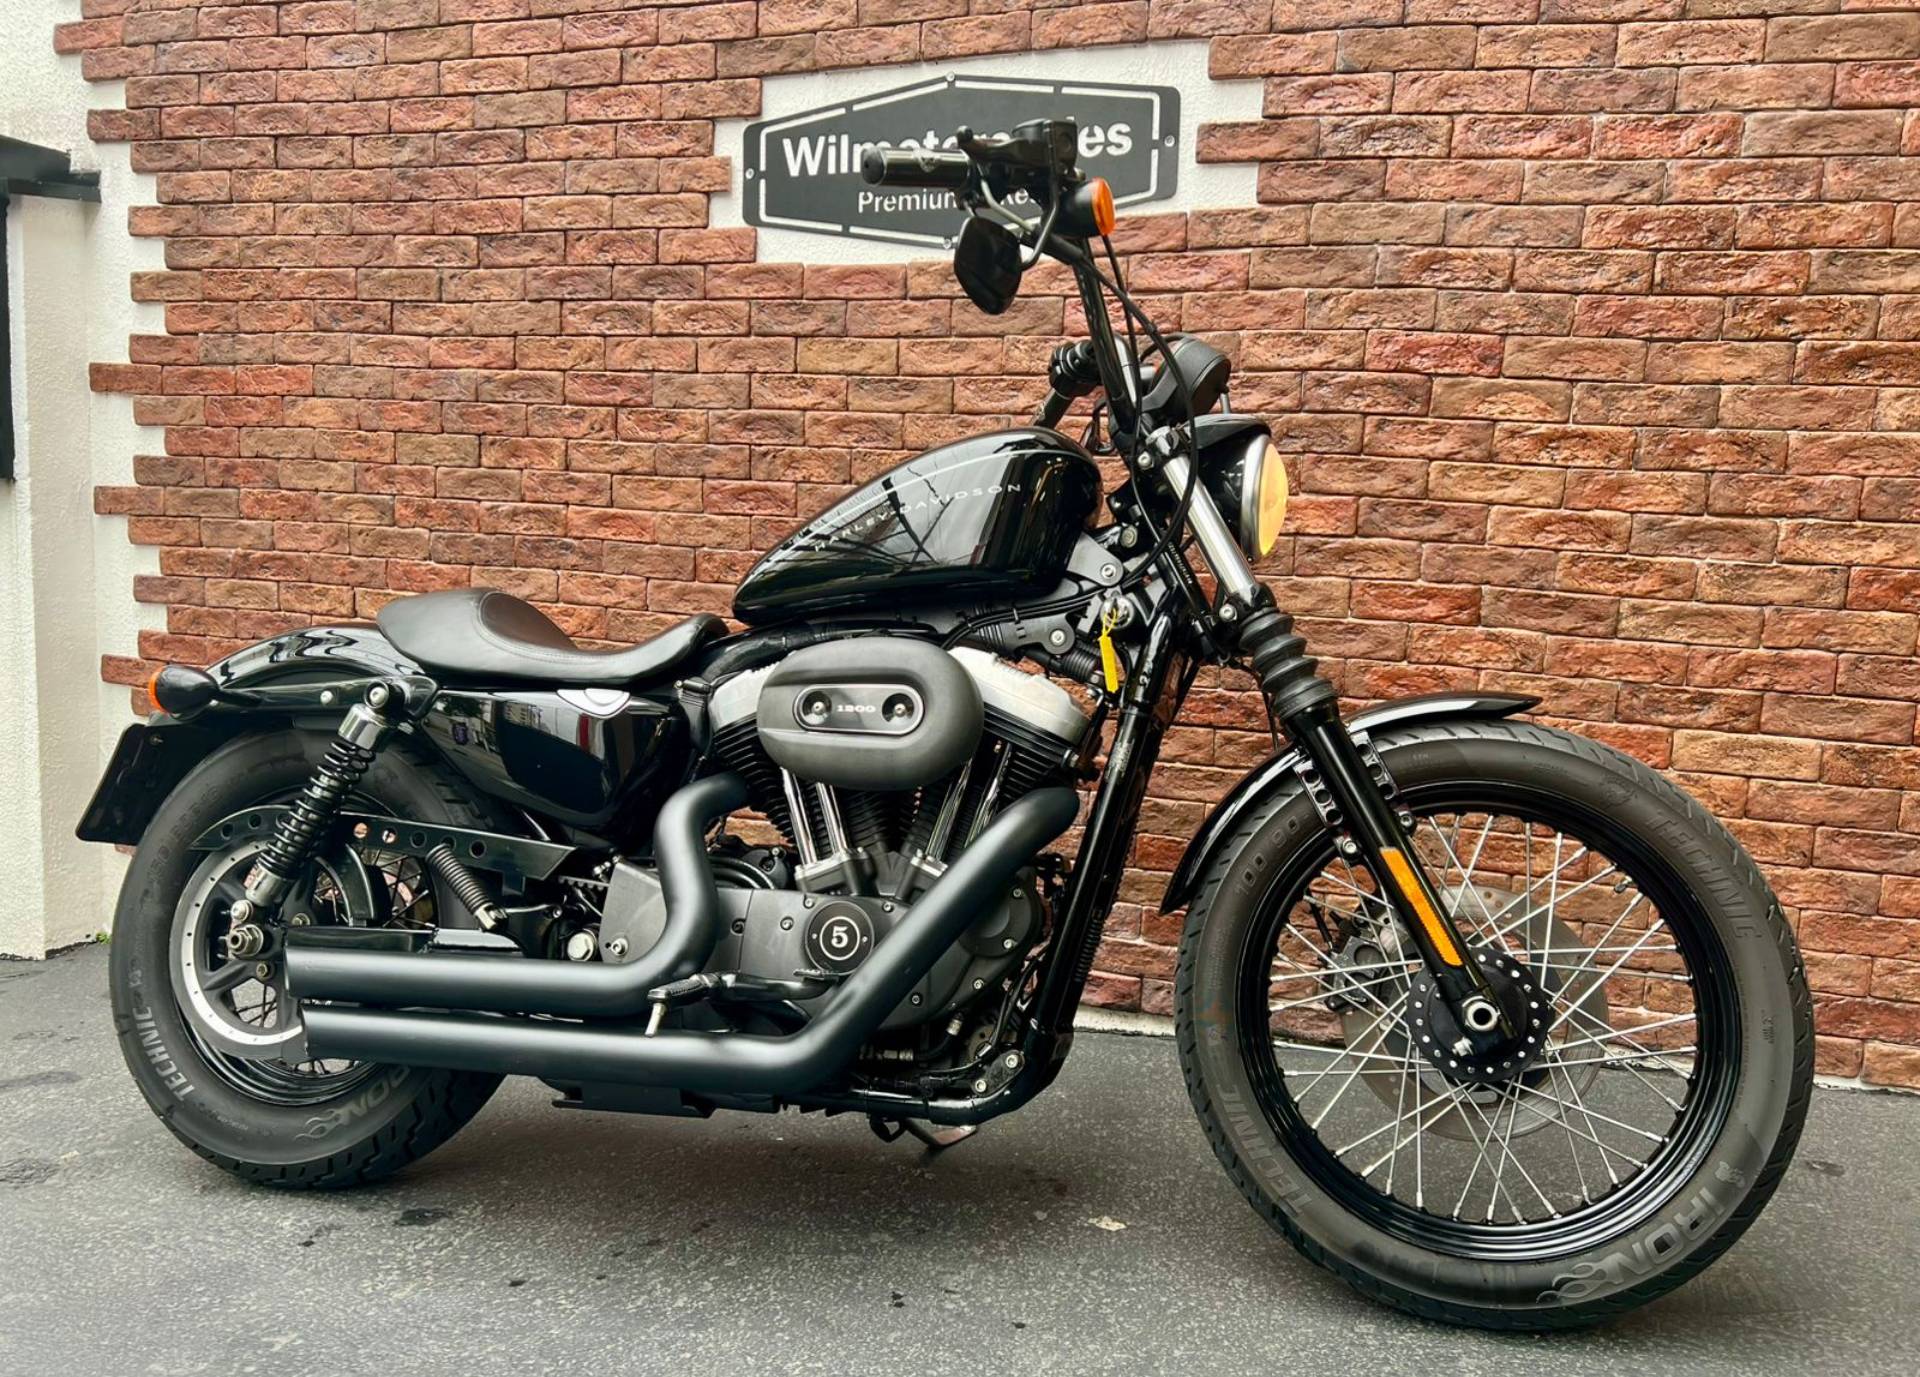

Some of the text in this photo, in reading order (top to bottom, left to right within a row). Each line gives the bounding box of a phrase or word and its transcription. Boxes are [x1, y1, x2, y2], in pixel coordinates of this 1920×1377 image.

[831, 925, 848, 948] 5
[132, 1006, 195, 1101] TECHNIC
[1603, 1186, 1726, 1285] IRON
